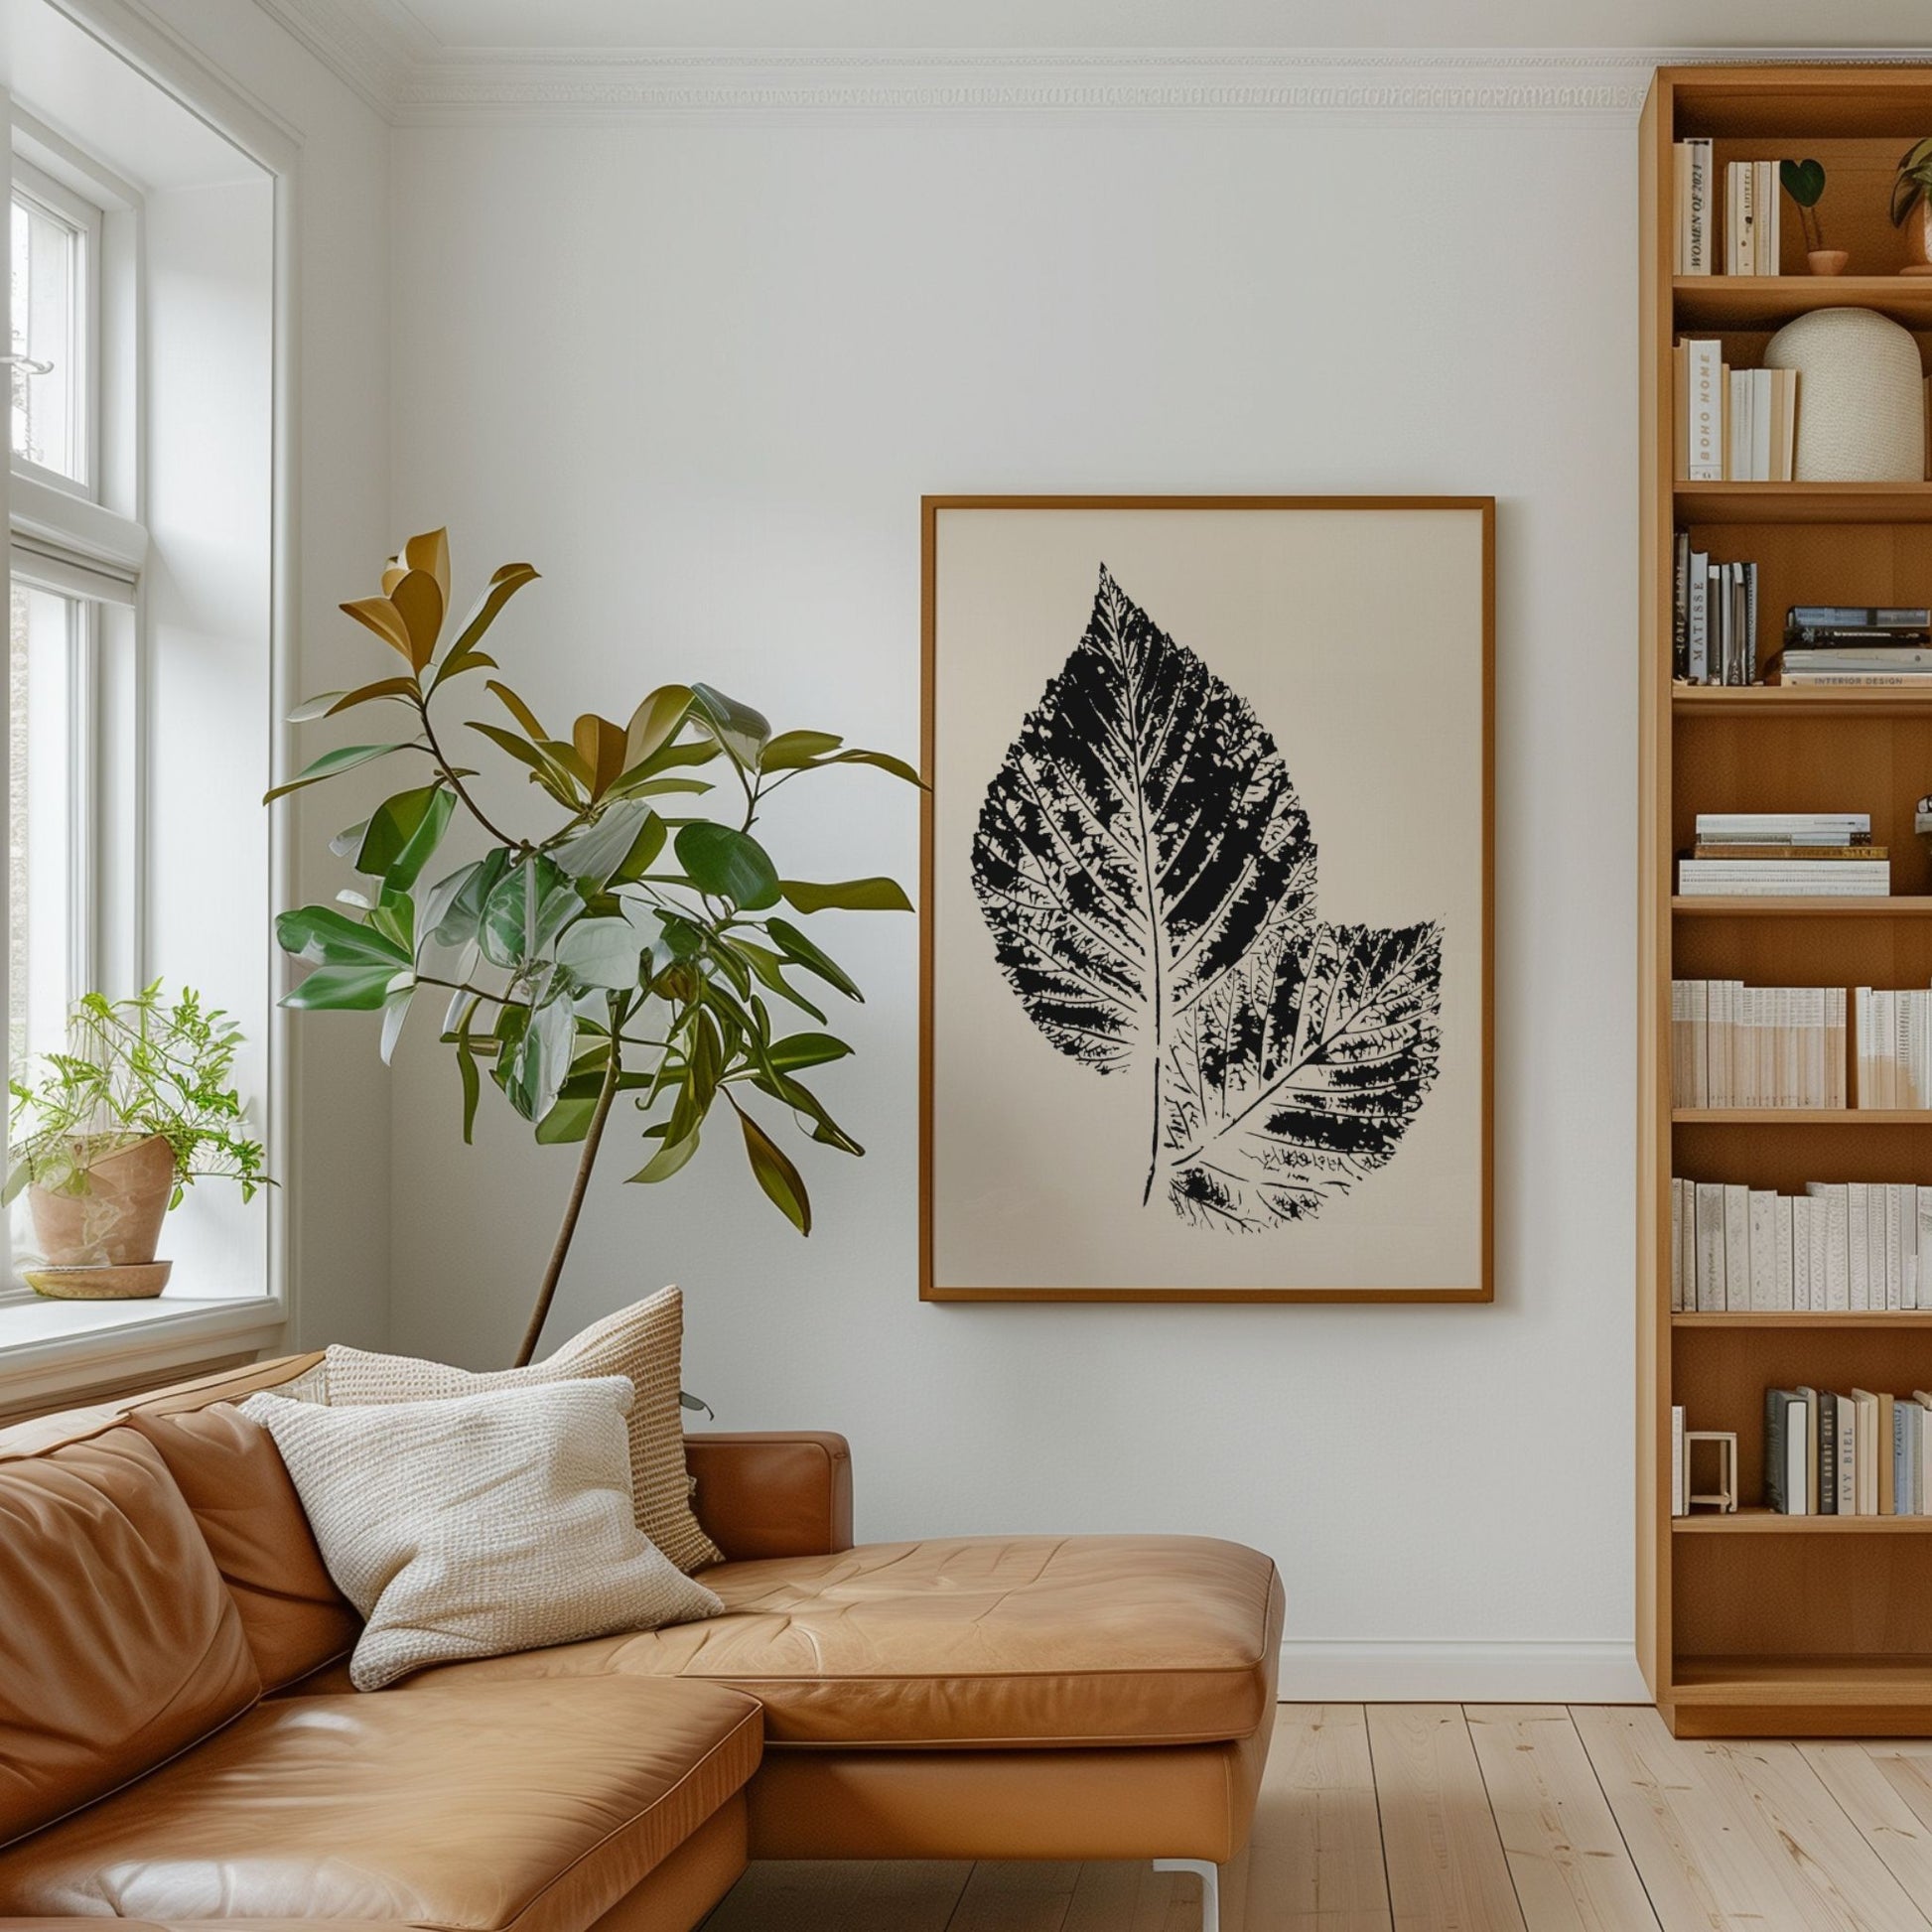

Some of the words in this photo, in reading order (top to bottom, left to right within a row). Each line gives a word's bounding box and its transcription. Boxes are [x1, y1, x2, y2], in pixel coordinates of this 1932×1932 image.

[1691, 194, 1703, 211] OF
[1691, 213, 1702, 267] WOMEN
[1700, 352, 1710, 403] HOME
[1700, 412, 1710, 461] BOHO
[1693, 582, 1704, 661] MATISSE
[1843, 1428, 1853, 1464] BIEL
[1843, 1473, 1853, 1501] IVY
